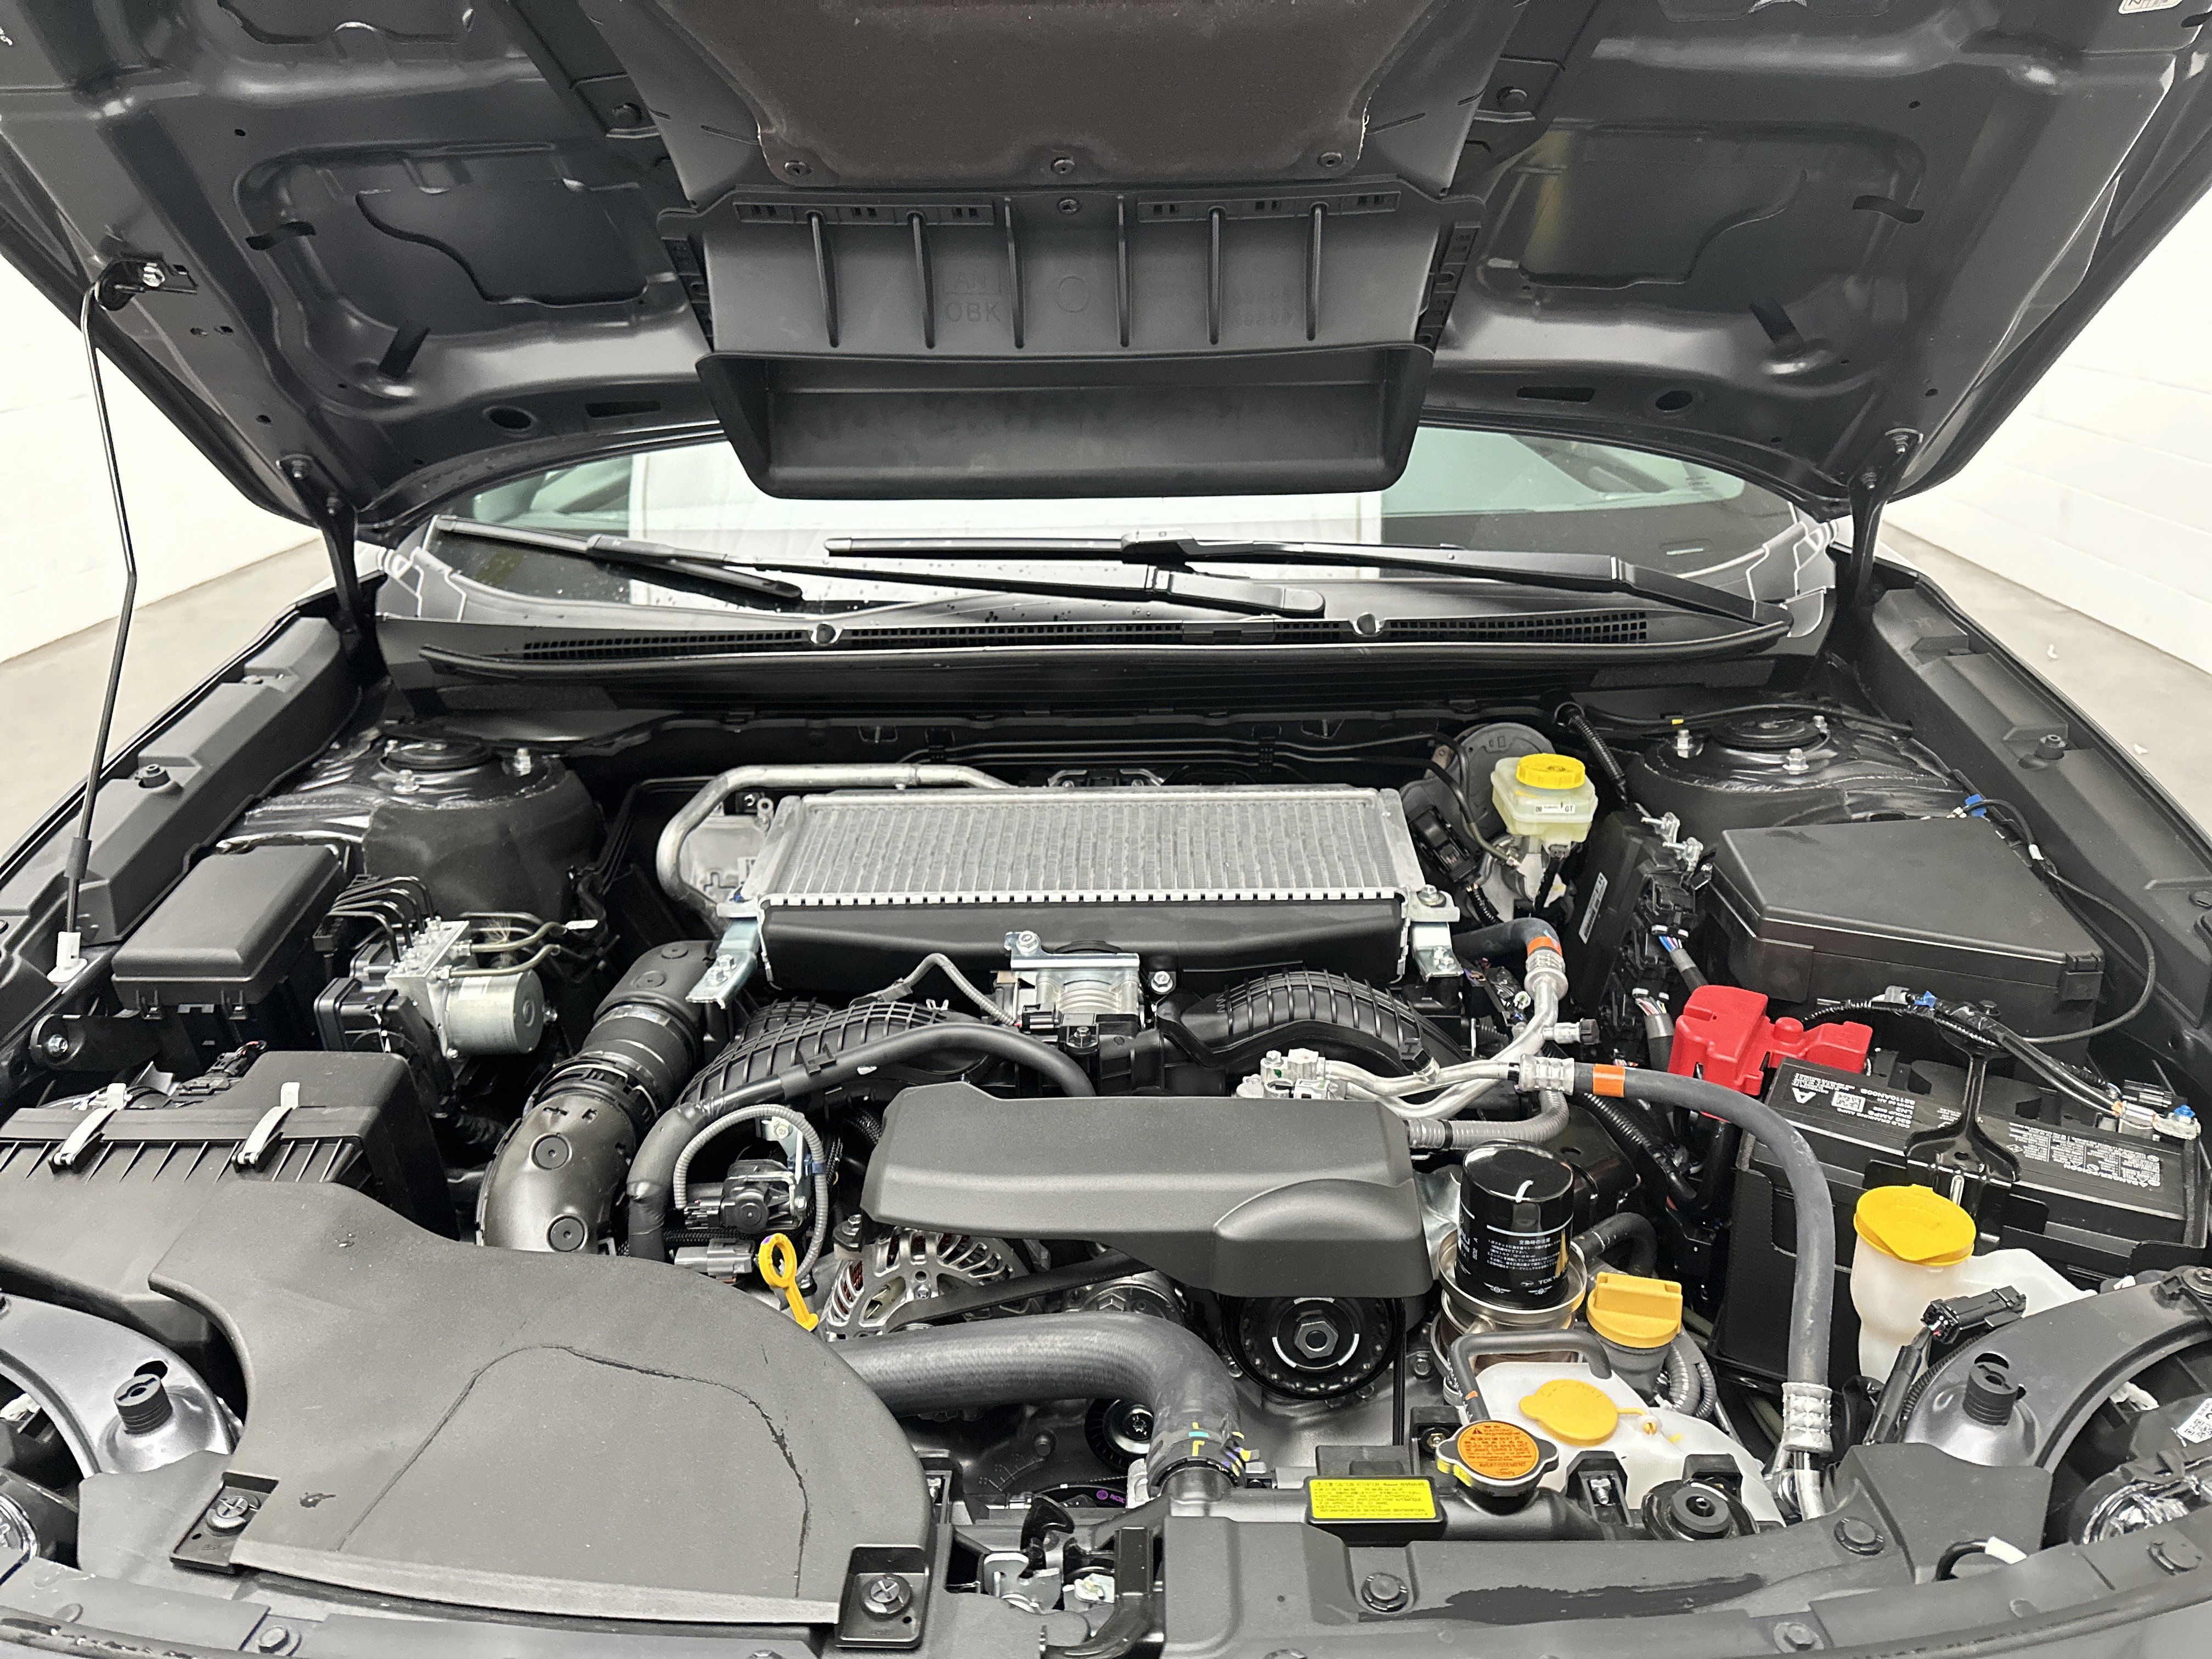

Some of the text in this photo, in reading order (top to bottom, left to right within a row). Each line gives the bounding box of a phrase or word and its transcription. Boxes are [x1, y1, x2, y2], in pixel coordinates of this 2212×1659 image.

[945, 300, 1001, 323] OBK
[1867, 1110, 1894, 1120] AMPS
[1888, 1110, 1912, 1119] GROUP
[1895, 1107, 1913, 1115] LN2
[1856, 1112, 1891, 1124] CRANKING
